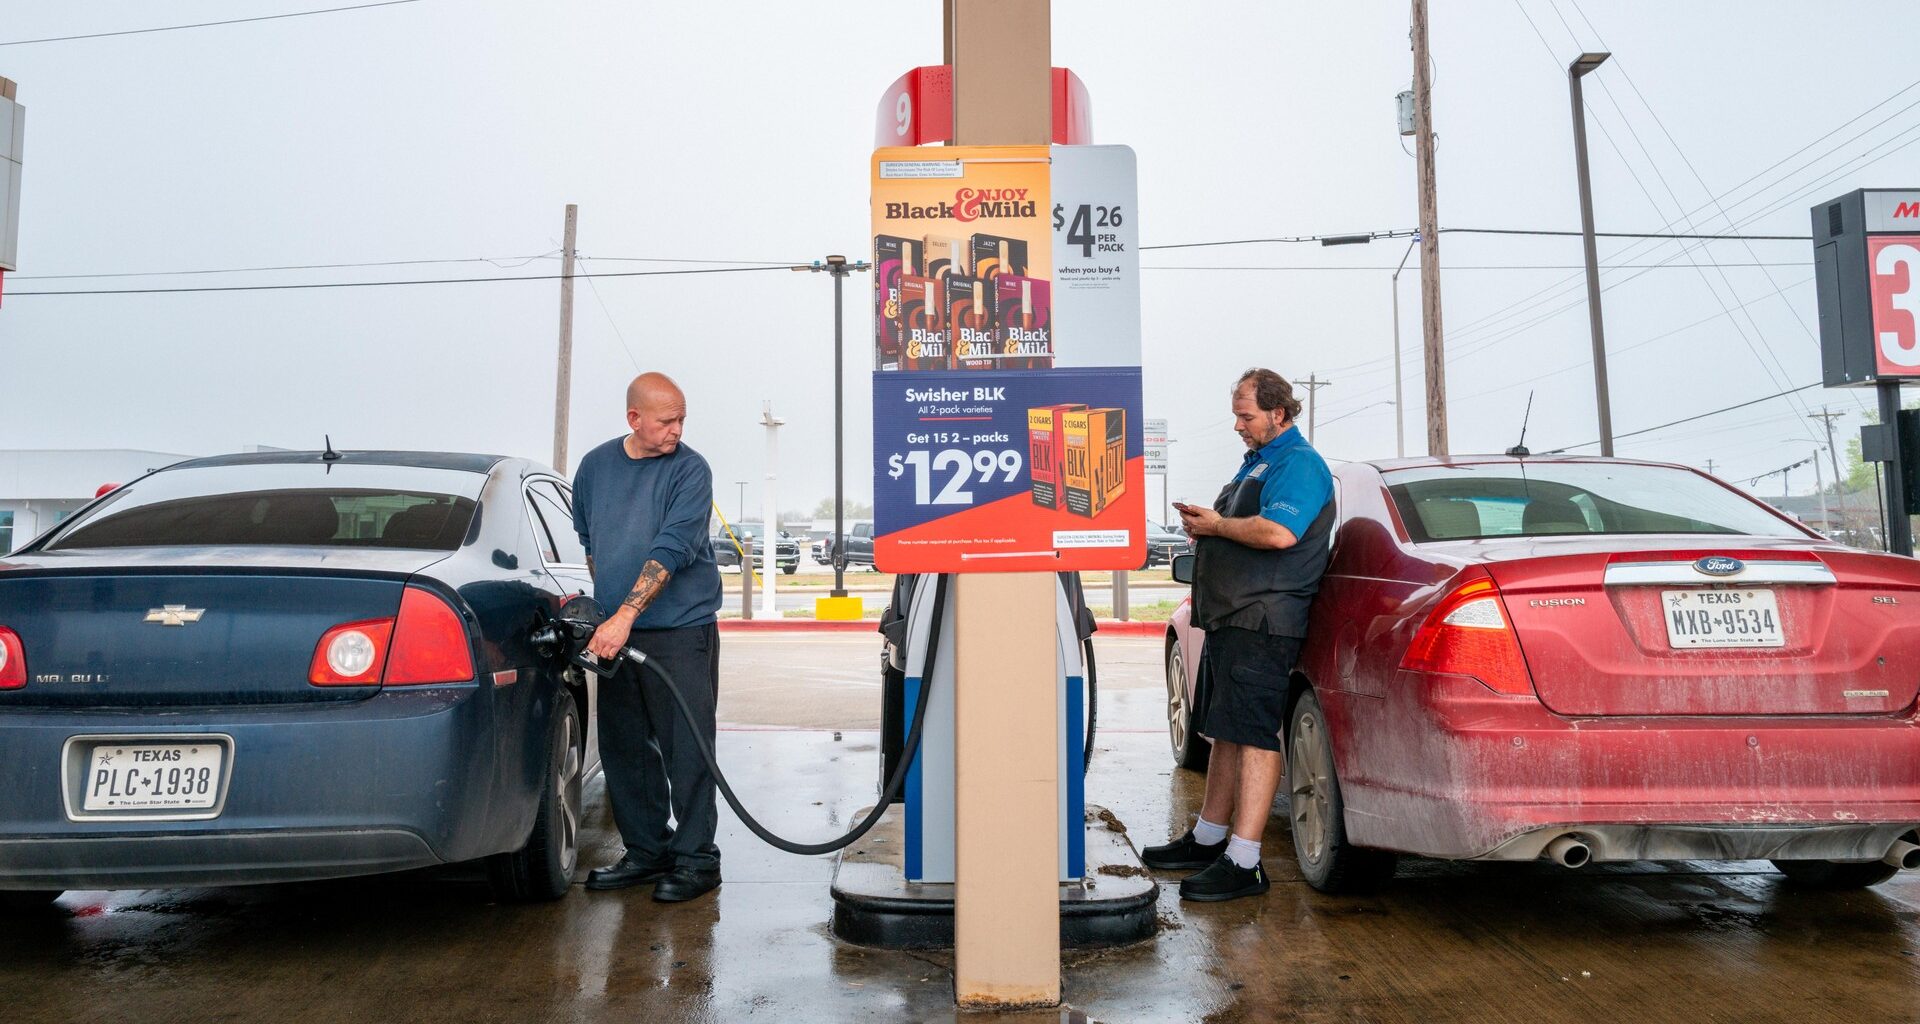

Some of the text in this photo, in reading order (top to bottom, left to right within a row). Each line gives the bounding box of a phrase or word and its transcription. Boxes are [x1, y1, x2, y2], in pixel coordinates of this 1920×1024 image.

[896, 92, 912, 136] 9
[1098, 234, 1116, 242] PER
[1098, 244, 1124, 252] PACK
[1098, 266, 1112, 274] buy
[960, 328, 991, 342] Blac
[1008, 327, 1048, 342] Black
[906, 387, 1006, 402] Swisher BLK
[930, 405, 960, 415] 2-pack
[1068, 421, 1086, 429] CIGARS
[907, 434, 929, 443] Get
[933, 433, 948, 443] 15
[952, 433, 960, 442] 2
[973, 432, 1008, 445] packs
[1033, 444, 1050, 472] BLK
[1145, 451, 1160, 461] eep
[1068, 449, 1086, 478] BLK
[1706, 559, 1735, 570] Ford
[1530, 598, 1585, 607] FUSION
[1697, 593, 1742, 604] TEXAS
[133, 750, 181, 762] TEXAS
